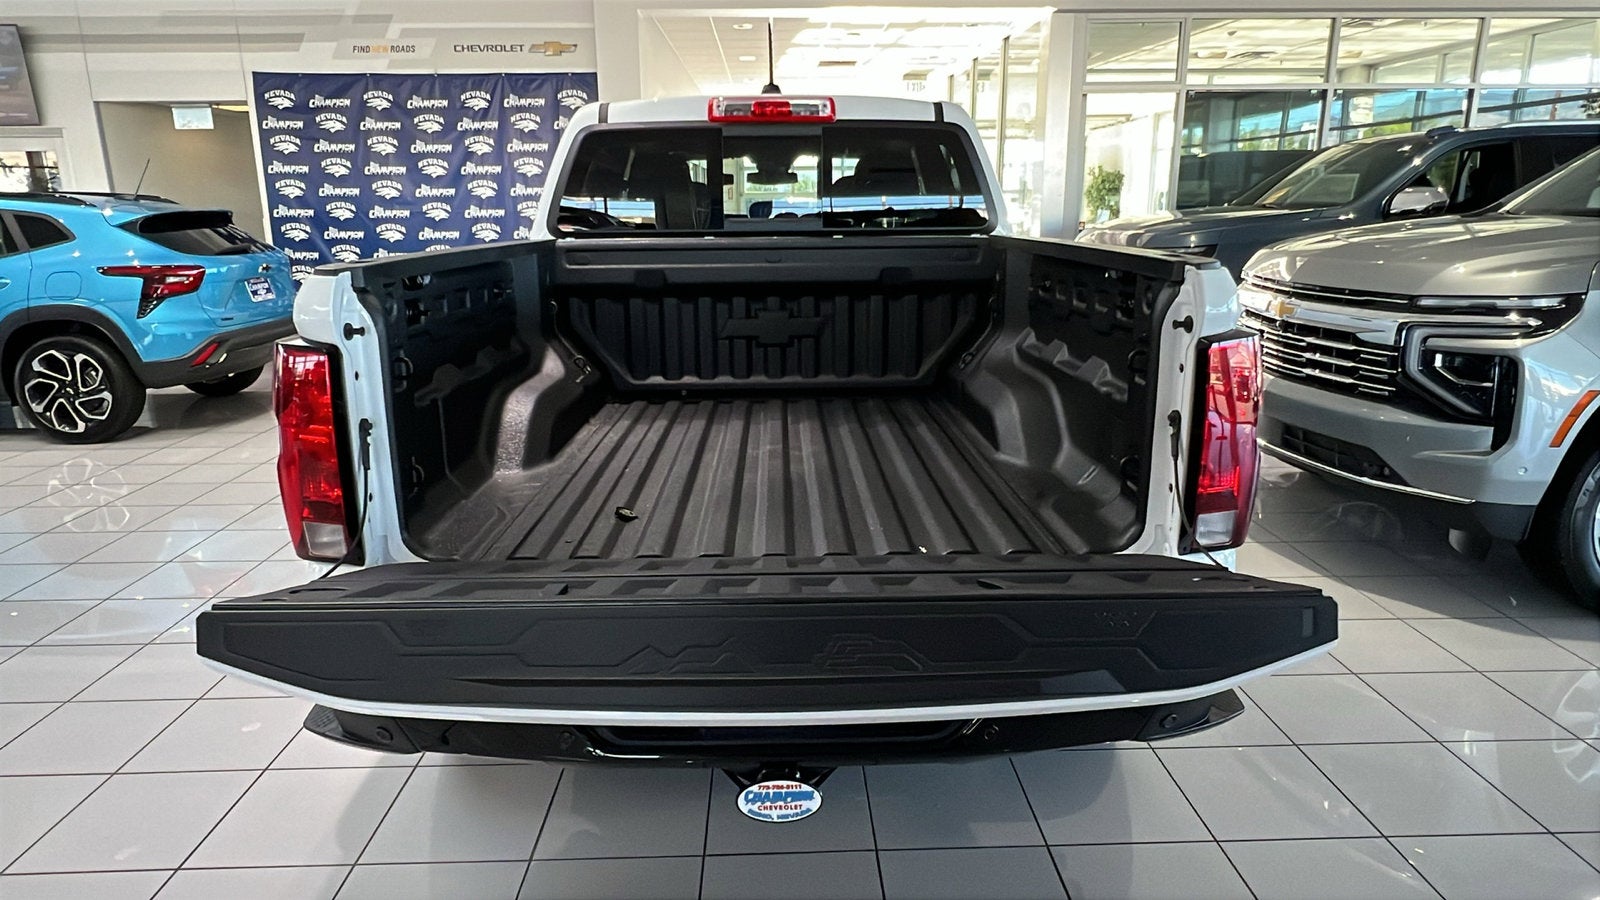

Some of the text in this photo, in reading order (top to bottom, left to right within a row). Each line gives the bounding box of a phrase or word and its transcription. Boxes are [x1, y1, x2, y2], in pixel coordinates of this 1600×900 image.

[352, 44, 371, 53] FIND
[390, 44, 416, 53] ROADS
[453, 44, 525, 53] CHEVROLET
[264, 89, 296, 101] NEVADA
[363, 90, 394, 102] NEVADA
[460, 90, 491, 101] NEVADA
[557, 89, 588, 100] NEVADA
[309, 98, 350, 108] CHAMPION
[407, 99, 448, 109] CHAMPION
[504, 98, 545, 108] CHAMPION
[315, 112, 348, 124] NEVADA
[414, 113, 445, 124] NEVADA
[510, 112, 542, 123] NEVADA
[262, 120, 304, 130] CHAMPION
[360, 121, 401, 131] CHAMPION
[457, 120, 498, 131] CHAMPION
[270, 134, 301, 146] NEVADA
[367, 136, 399, 147] NEVADA
[464, 136, 495, 146] NEVADA
[314, 143, 356, 153] CHAMPION
[410, 143, 452, 154] CHAMPION
[506, 142, 548, 153] CHAMPION
[320, 158, 352, 168] NEVADA
[418, 158, 449, 169] NEVADA
[514, 157, 545, 168] NEVADA
[268, 164, 309, 174] CHAMPION
[364, 166, 406, 175] CHAMPION
[461, 165, 502, 176] CHAMPION
[275, 179, 306, 190] NEVADA
[372, 180, 403, 191] NEVADA
[467, 180, 498, 191] NEVADA
[318, 187, 360, 197] CHAMPION
[415, 188, 456, 198] CHAMPION
[326, 202, 356, 213] NEVADA
[422, 202, 452, 212] NEVADA
[273, 208, 314, 218] CHAMPION
[368, 208, 410, 218] CHAMPION
[464, 208, 506, 218] CHAMPION
[280, 222, 312, 234] NEVADA
[376, 223, 406, 234] NEVADA
[472, 222, 502, 234] NEVADA
[324, 230, 364, 240] CHAMPION
[418, 230, 460, 240] CHAMPION
[331, 244, 361, 255] NEVADA
